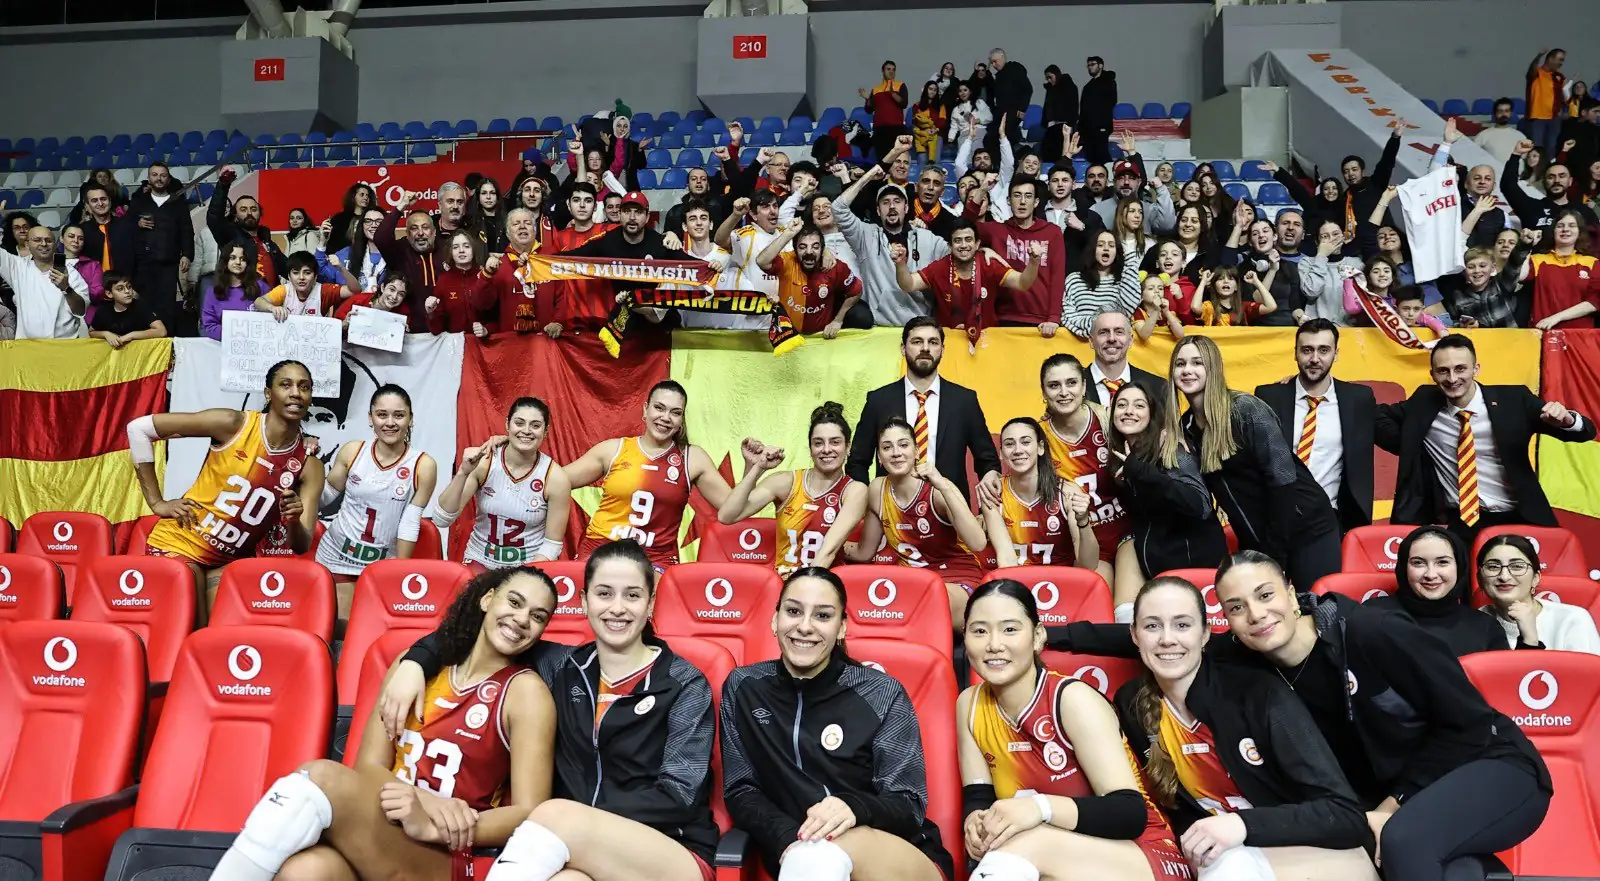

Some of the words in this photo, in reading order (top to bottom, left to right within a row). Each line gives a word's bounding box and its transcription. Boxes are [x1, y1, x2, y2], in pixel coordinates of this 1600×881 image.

[740, 41, 762, 52] 210
[260, 65, 277, 75] 211
[550, 262, 589, 275] SEN
[594, 260, 699, 282] MÜHİMSİN
[231, 319, 277, 339] HER
[214, 474, 276, 527] 20
[628, 489, 655, 527] 9
[200, 511, 251, 549] HDI
[361, 506, 377, 544] 1
[487, 512, 527, 548] 12
[609, 524, 656, 547] HDI
[47, 543, 78, 551] vodafone
[341, 536, 389, 561] HDI
[484, 542, 527, 563] HDI
[784, 528, 825, 568] 18
[731, 552, 767, 560] vodafone
[1377, 561, 1396, 569] voda
[111, 597, 151, 606] vodafone
[251, 600, 291, 609] vodafone
[393, 602, 435, 612] vodafone
[554, 606, 583, 614] afone
[696, 608, 741, 618] vodafone
[858, 608, 904, 619] vodafone
[1039, 613, 1067, 622] afone
[32, 674, 86, 687] vodafone
[217, 683, 272, 696] vodafone
[396, 728, 463, 798] 33
